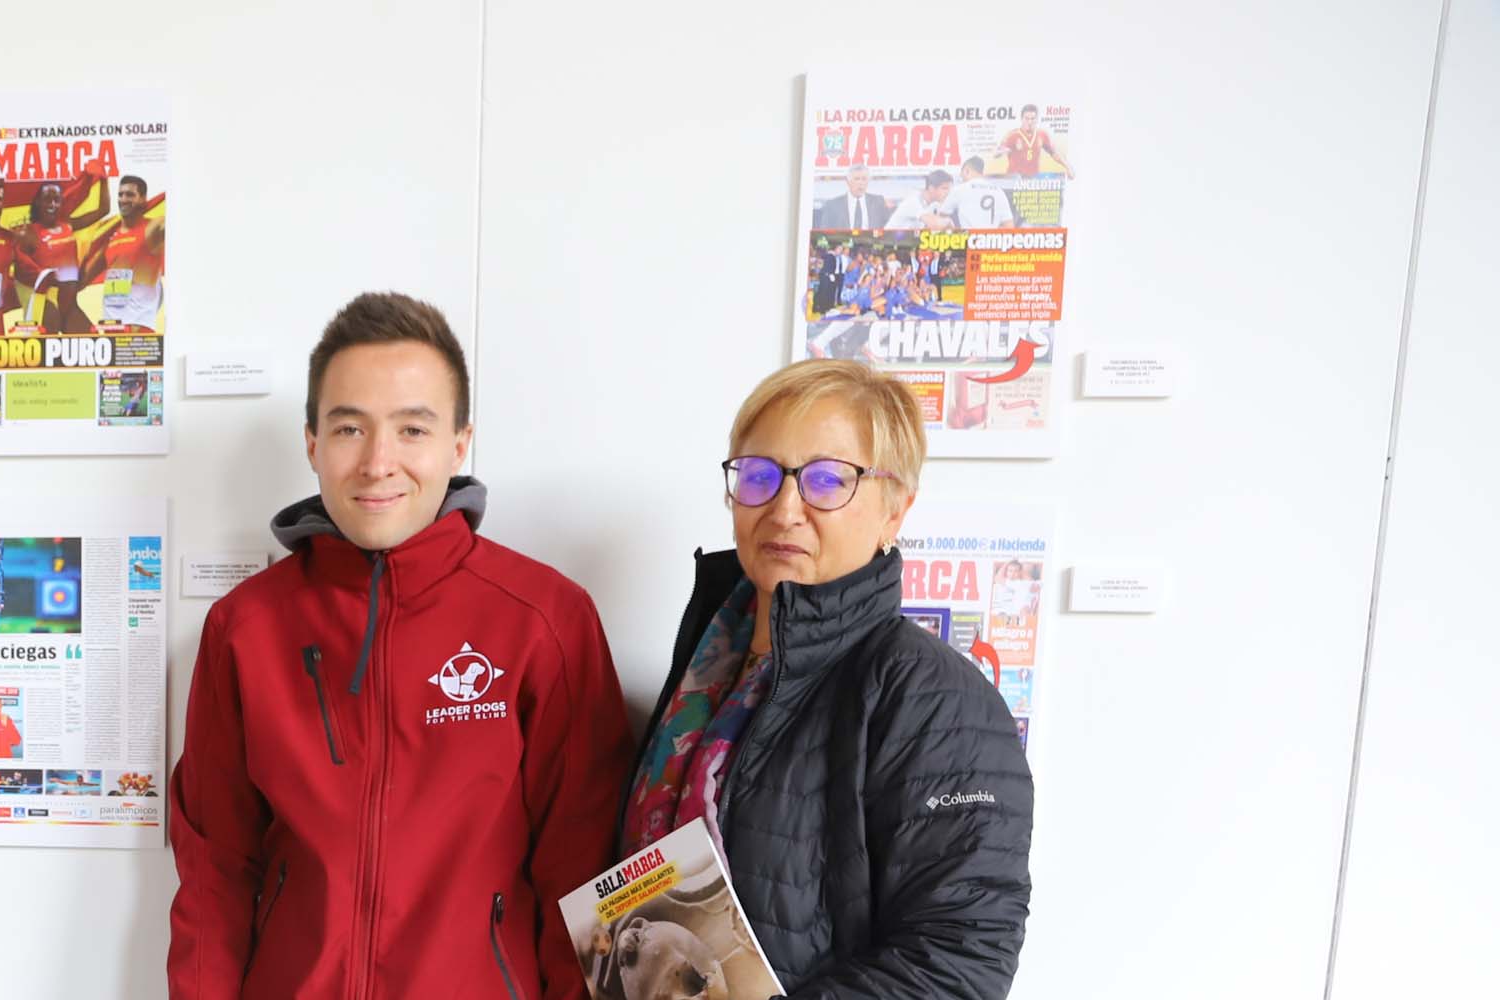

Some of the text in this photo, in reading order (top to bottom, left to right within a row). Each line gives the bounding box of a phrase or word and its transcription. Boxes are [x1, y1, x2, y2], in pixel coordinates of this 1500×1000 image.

[824, 107, 1016, 123] LA ROJA LA CASA DEL GOL
[1046, 105, 1071, 116] Koke
[19, 125, 97, 139] EXTRAÑADOS
[99, 124, 123, 136] CON
[125, 122, 168, 135] SOLARI
[815, 125, 961, 167] MARCA
[980, 194, 996, 224] 9
[919, 230, 1064, 252] Supercampeonas
[45, 337, 112, 367] PURO
[998, 538, 1046, 551] Hacienda
[901, 559, 980, 600] RCA
[0, 643, 57, 662] ciegas
[426, 701, 506, 718] LEADER DOGS
[426, 711, 507, 725] FOR THE BLIND
[940, 790, 996, 807] Columbia
[595, 848, 665, 898] SALAMARCA
[642, 866, 675, 889] BRILLANTES
